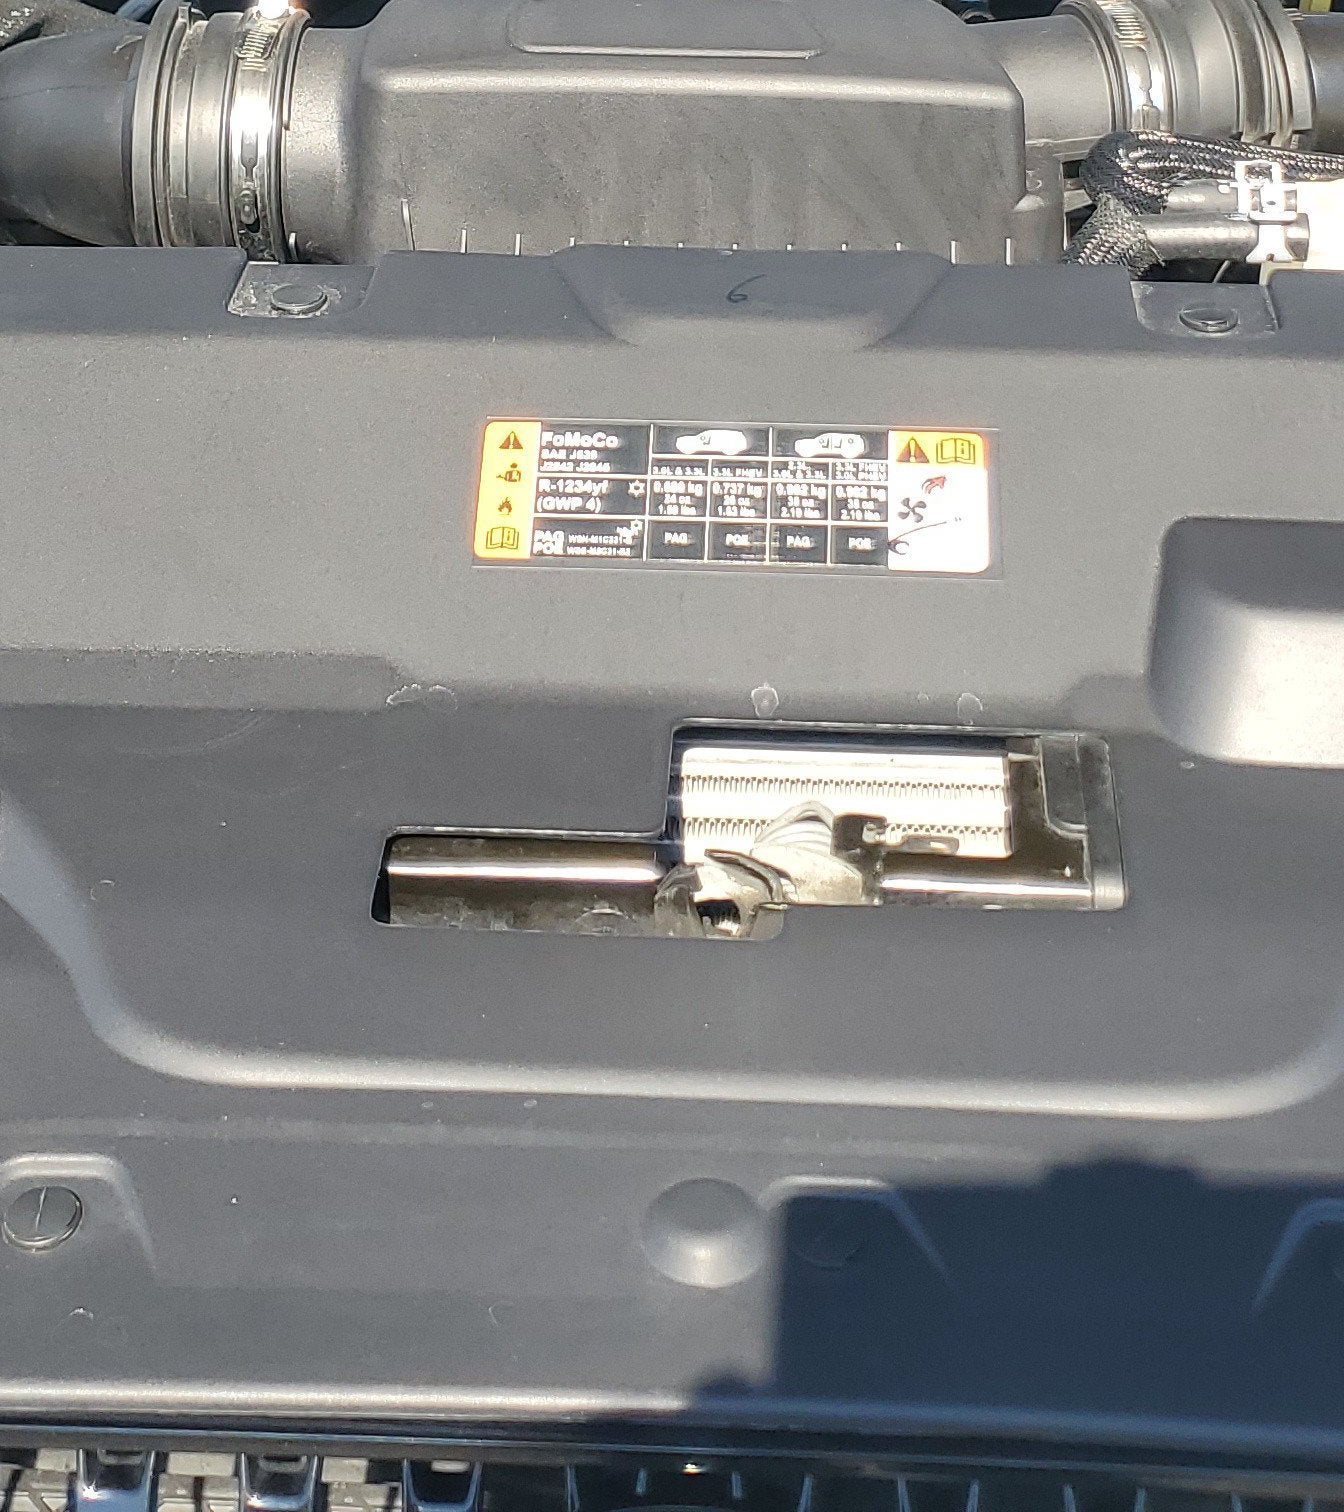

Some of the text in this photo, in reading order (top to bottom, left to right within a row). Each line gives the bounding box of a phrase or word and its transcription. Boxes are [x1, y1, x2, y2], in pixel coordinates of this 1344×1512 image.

[541, 431, 619, 448] FoMoCo
[538, 478, 609, 497] R-1234yf
[687, 480, 703, 497] kg
[746, 483, 763, 498] kg
[810, 484, 826, 499] kg
[871, 486, 887, 502] kg
[537, 495, 602, 514] (GWP 4)
[534, 529, 565, 543] PAG
[664, 531, 688, 544] PAG
[725, 533, 749, 546] POE
[786, 535, 811, 548] PAG
[532, 541, 564, 555] POE
